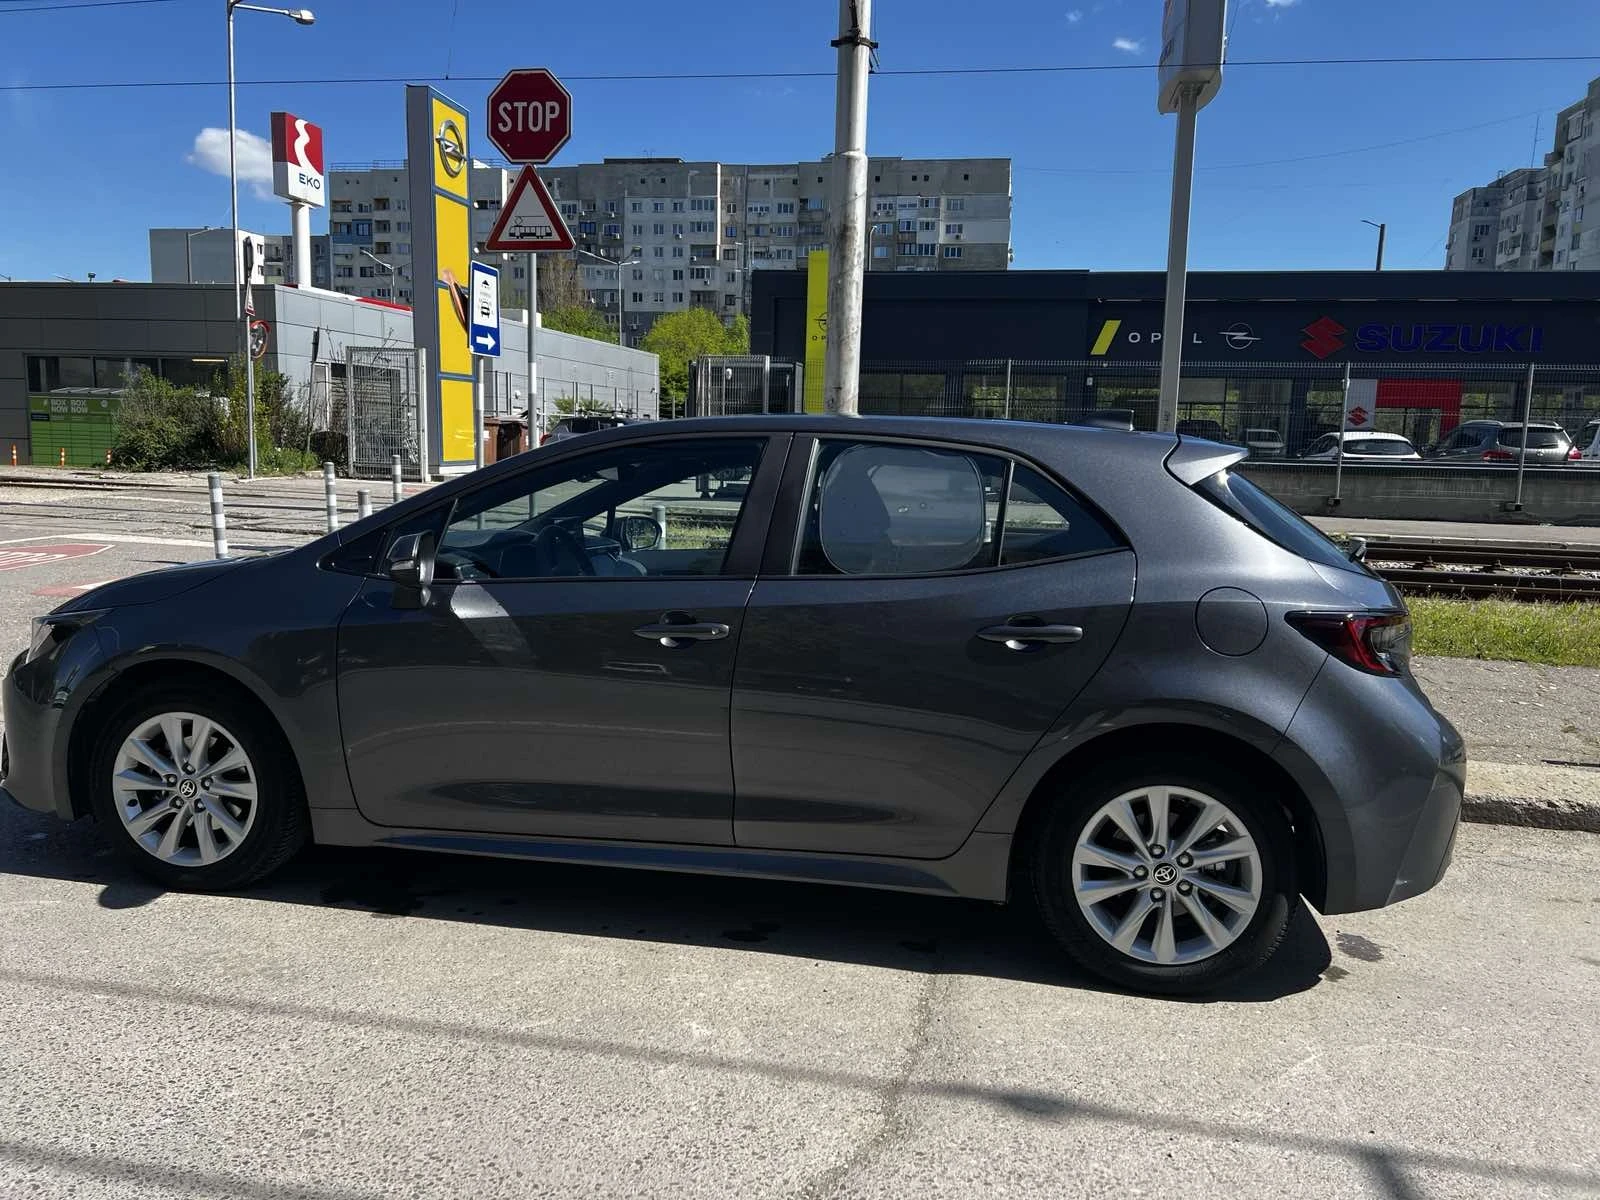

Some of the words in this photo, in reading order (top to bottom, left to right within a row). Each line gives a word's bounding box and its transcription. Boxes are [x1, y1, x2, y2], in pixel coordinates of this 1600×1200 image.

[498, 101, 560, 132] STOP
[299, 173, 321, 189] EKO
[1128, 332, 1203, 343] OPL
[1353, 322, 1543, 352] SUZUKI
